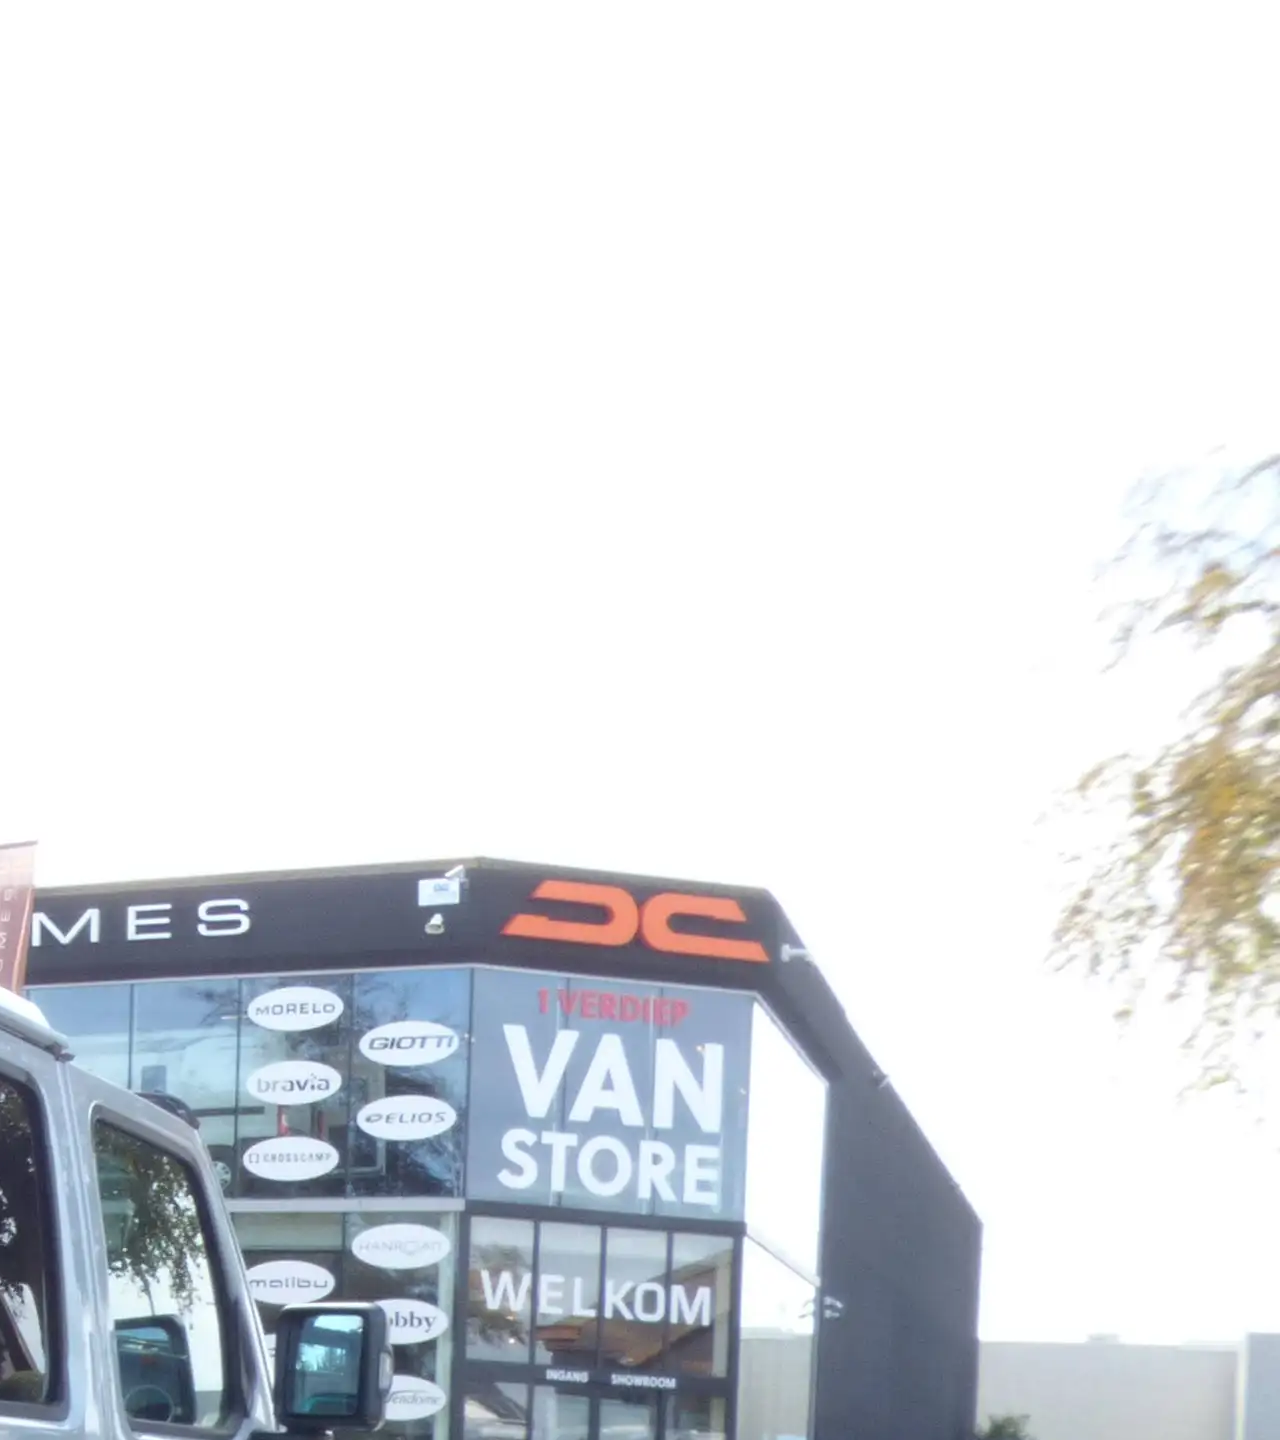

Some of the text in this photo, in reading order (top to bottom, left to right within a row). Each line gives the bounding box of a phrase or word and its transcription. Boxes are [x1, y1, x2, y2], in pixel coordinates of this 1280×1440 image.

[255, 1002, 336, 1016] MORELO
[556, 989, 689, 1027] VERDIEP
[368, 1035, 455, 1051] GIOTTI
[256, 1073, 331, 1094] bravia
[503, 1024, 724, 1133] VAN
[497, 1129, 720, 1208] STORE
[249, 1276, 328, 1289] malibu
[480, 1269, 711, 1327] WELKOM
[546, 1368, 677, 1389] INGANG SHOWROOM
